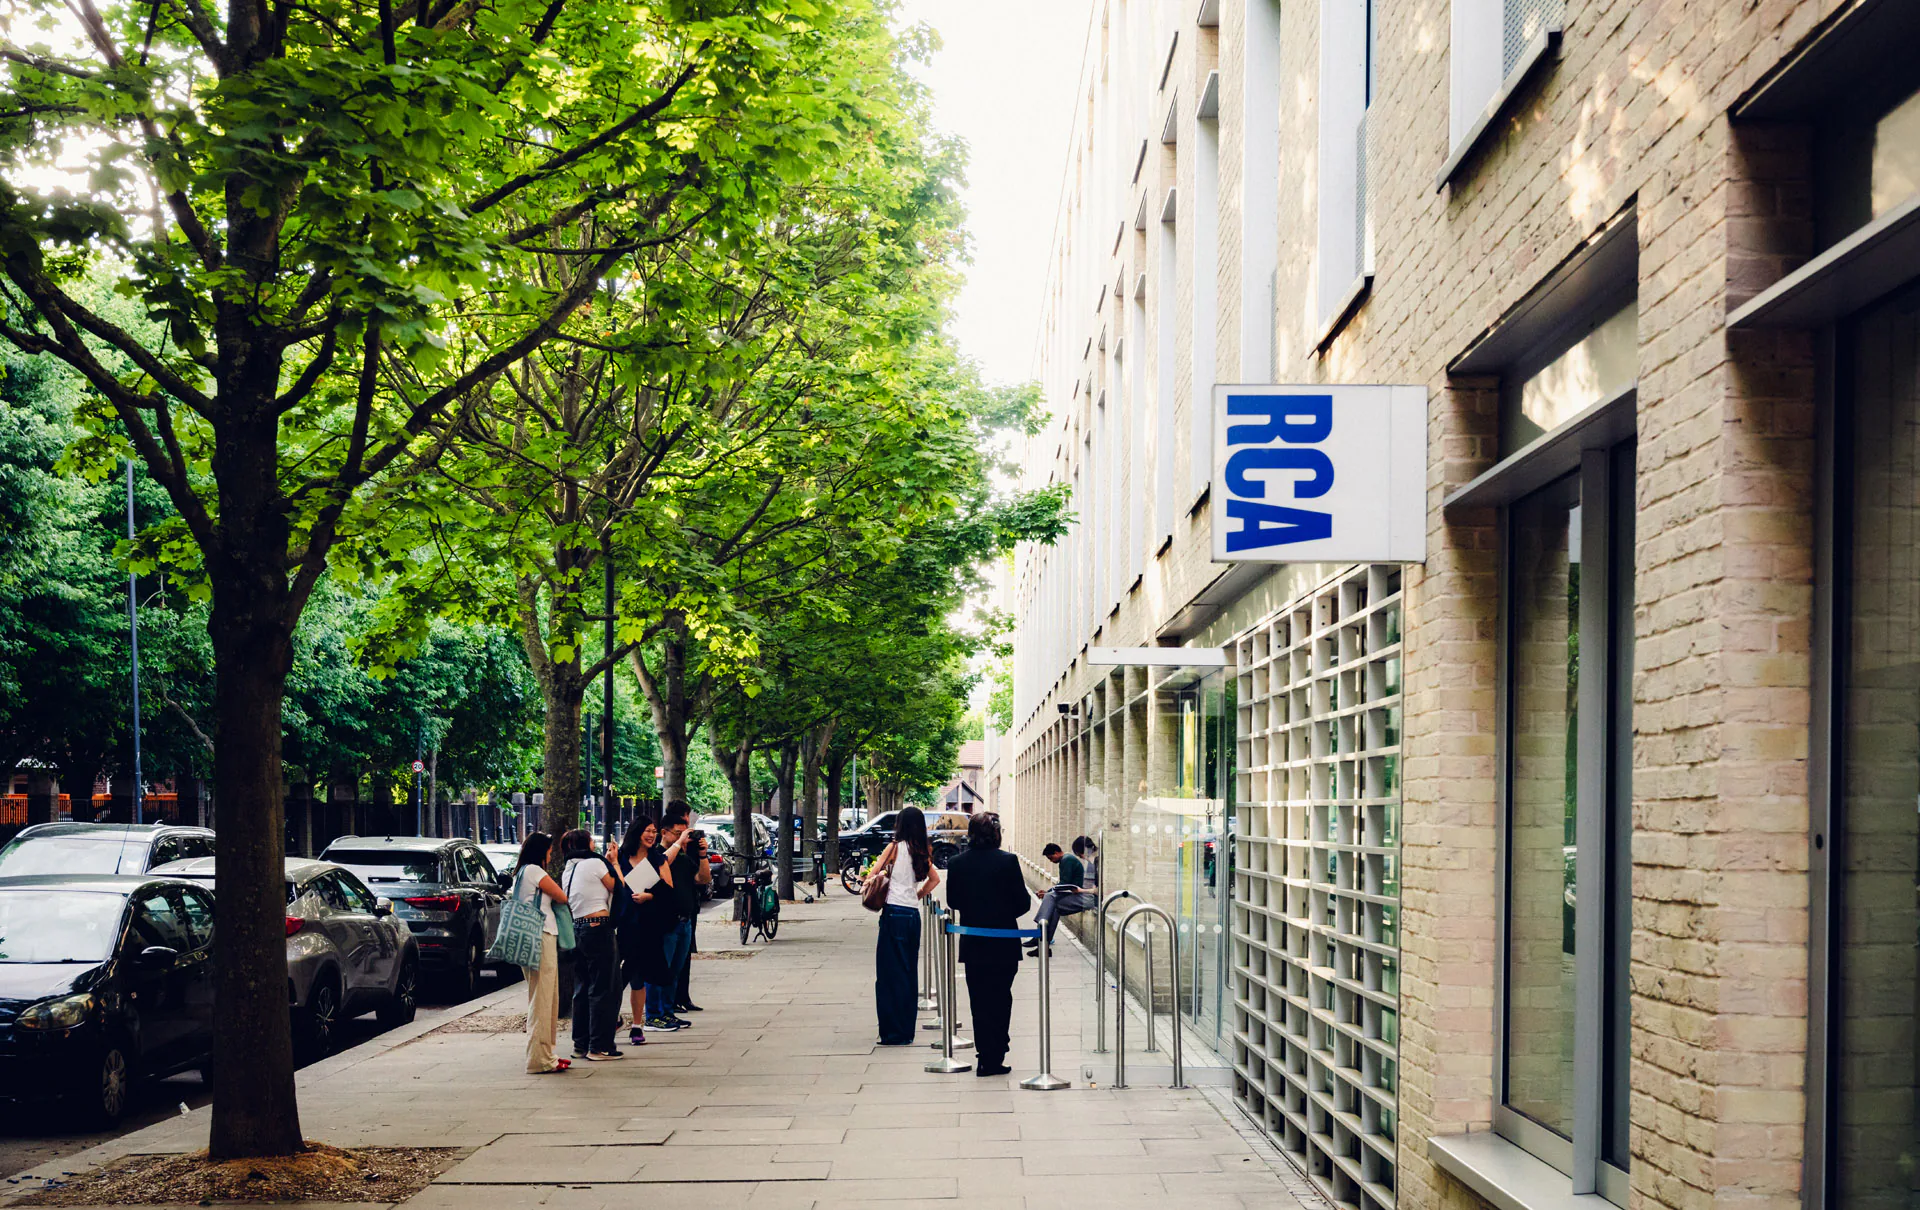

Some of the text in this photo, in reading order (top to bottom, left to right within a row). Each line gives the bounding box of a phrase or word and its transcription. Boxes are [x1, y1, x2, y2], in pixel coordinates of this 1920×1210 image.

[1225, 395, 1334, 553] RCA
[794, 819, 800, 827] P
[513, 918, 539, 934] HUGO
[505, 931, 518, 961] HUGO
